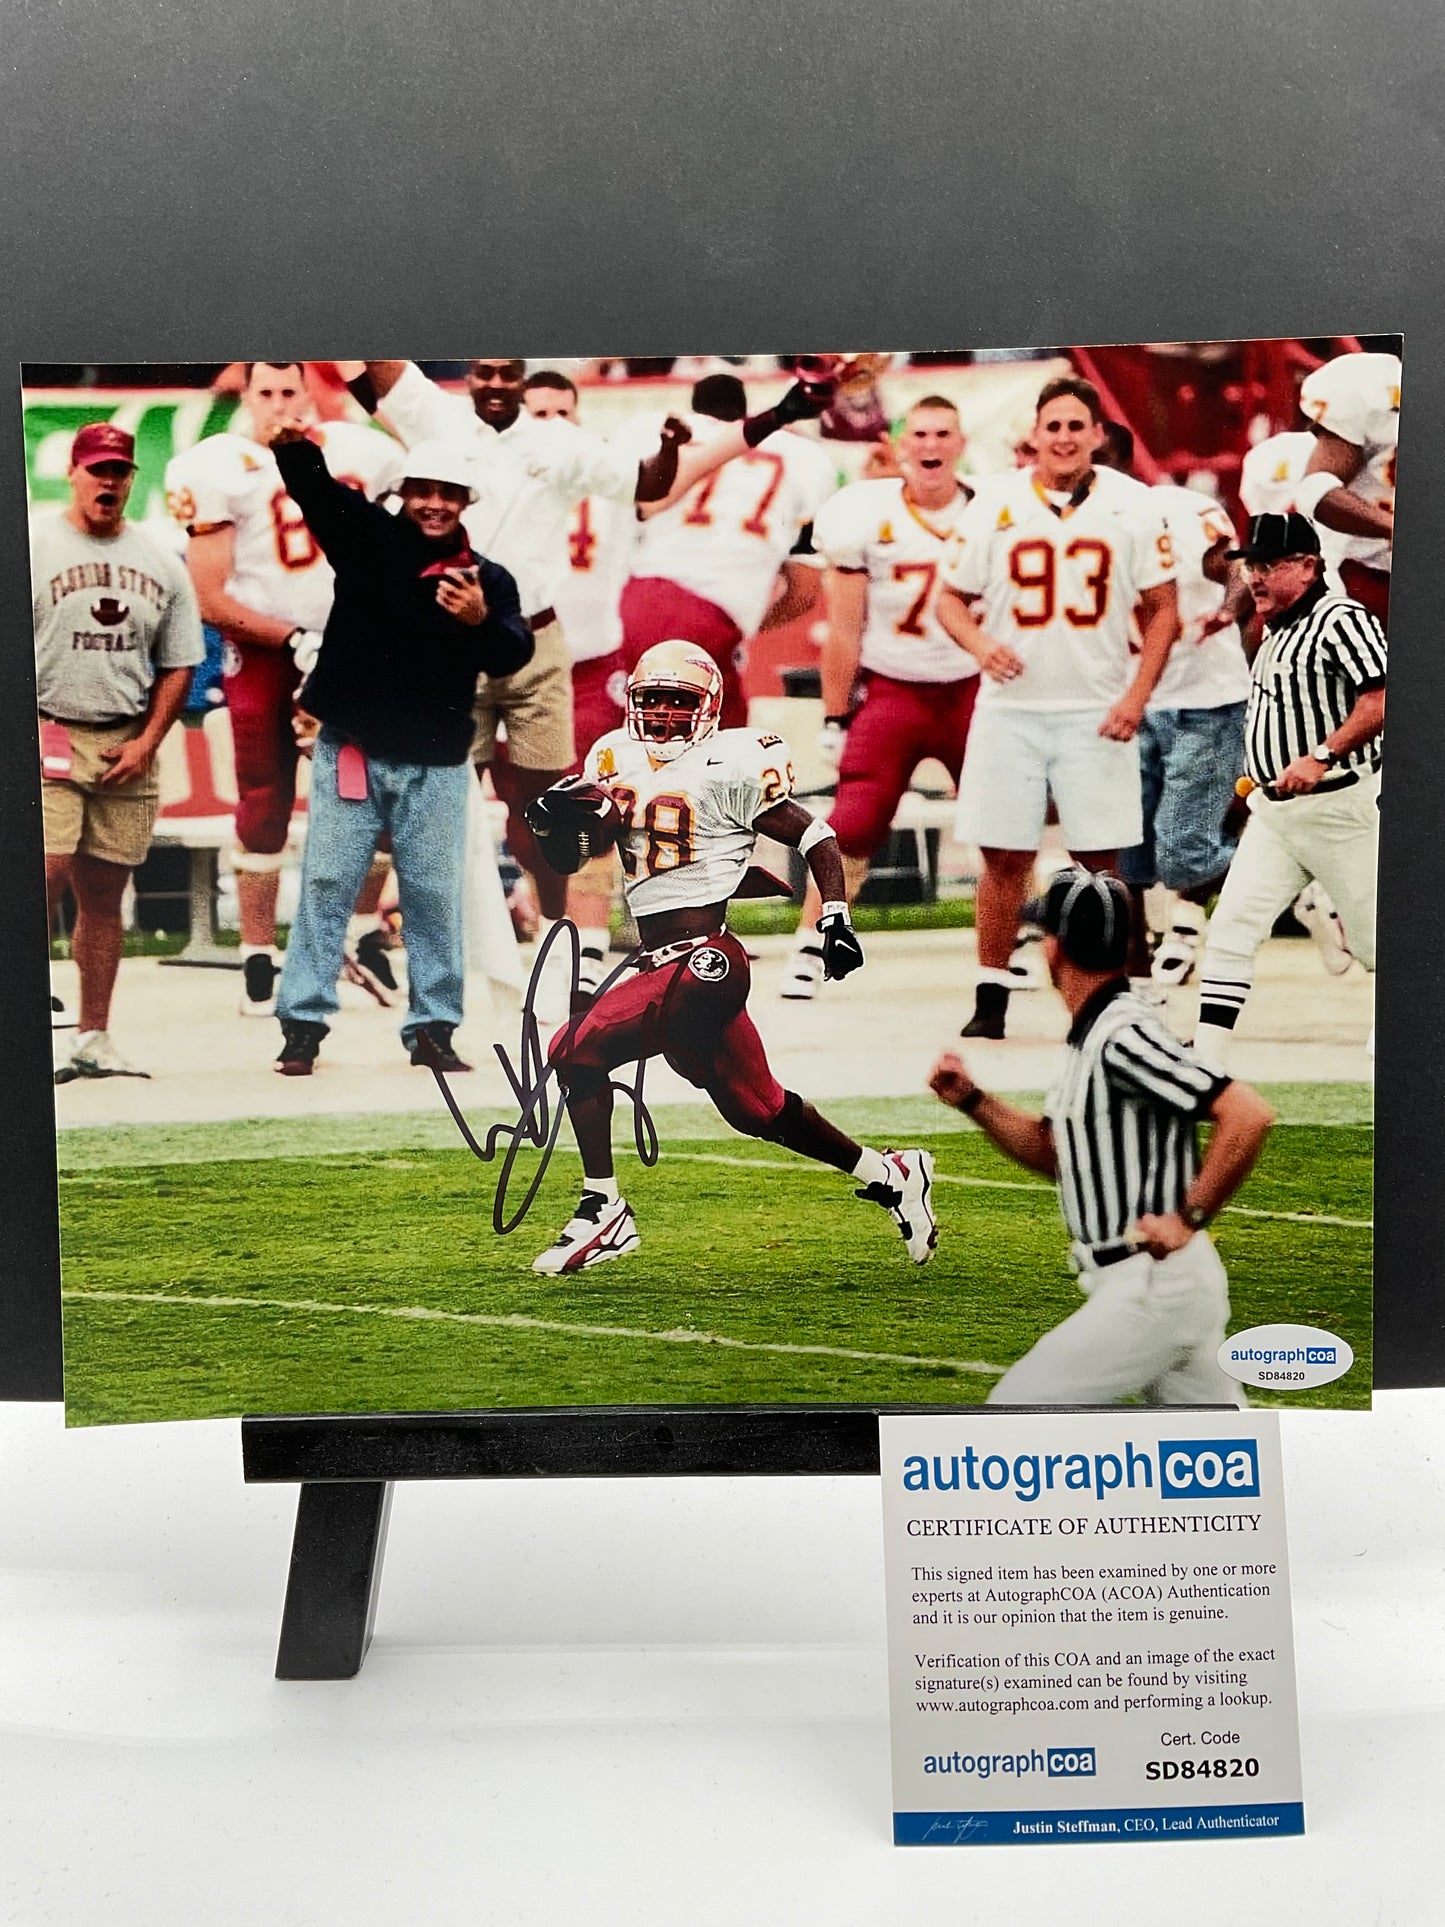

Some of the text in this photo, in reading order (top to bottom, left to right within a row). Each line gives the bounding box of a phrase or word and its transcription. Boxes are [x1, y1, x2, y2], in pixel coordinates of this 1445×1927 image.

[1008, 536, 1112, 630] 93
[891, 560, 938, 638] 7
[1258, 1371, 1306, 1381] SD84820
[907, 1514, 1261, 1537] CERTIFICATE OF AUTHENTICITY
[911, 1563, 1276, 1585] This signed item has been examined by one or more
[912, 1582, 1270, 1607] experts at AutographCOA (ACOA) Authentication
[913, 1605, 1228, 1628] and it is our opinion that the item is genuine.
[914, 1648, 1275, 1669] Verification of this COA and an image of the exact
[915, 1669, 1248, 1694] signature(s) examined can be found by visiting
[916, 1690, 1272, 1716] www.autographcoa.com and performing a lookup.
[1161, 1730, 1240, 1747] Cert. Code
[1146, 1757, 1259, 1781] SD84820
[1013, 1814, 1279, 1834] Justin Steffman, CEO, Lead Authenticator
